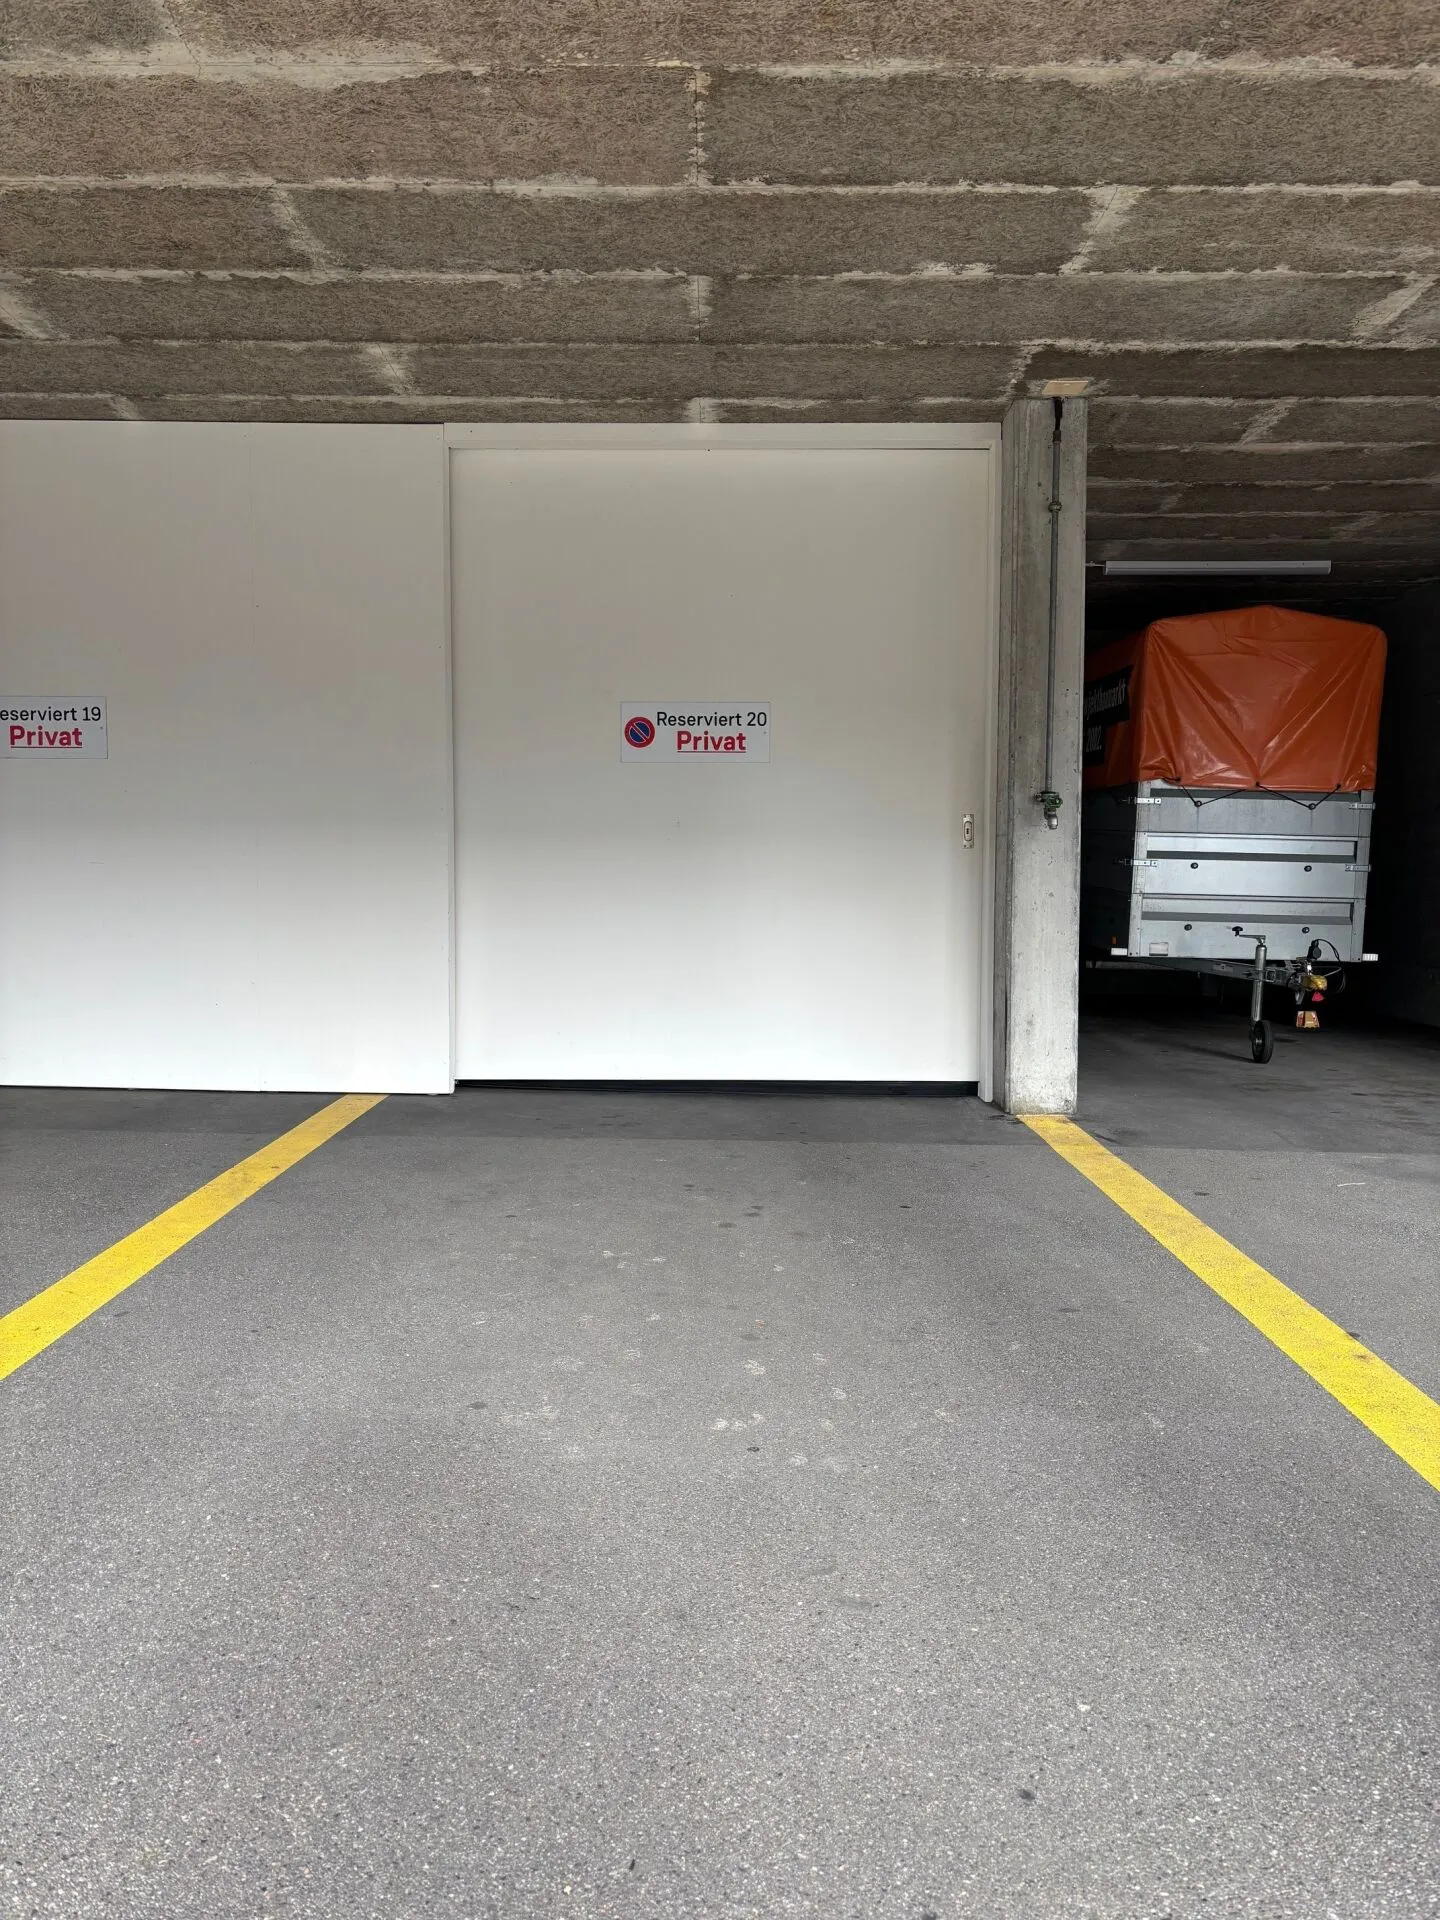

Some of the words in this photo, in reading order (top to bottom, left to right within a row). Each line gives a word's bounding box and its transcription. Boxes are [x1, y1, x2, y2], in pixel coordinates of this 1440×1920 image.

[82, 706, 101, 721] 19
[656, 711, 742, 727] Reserviert
[746, 711, 768, 727] 20
[9, 725, 83, 747] Privat
[676, 730, 747, 751] Privat
